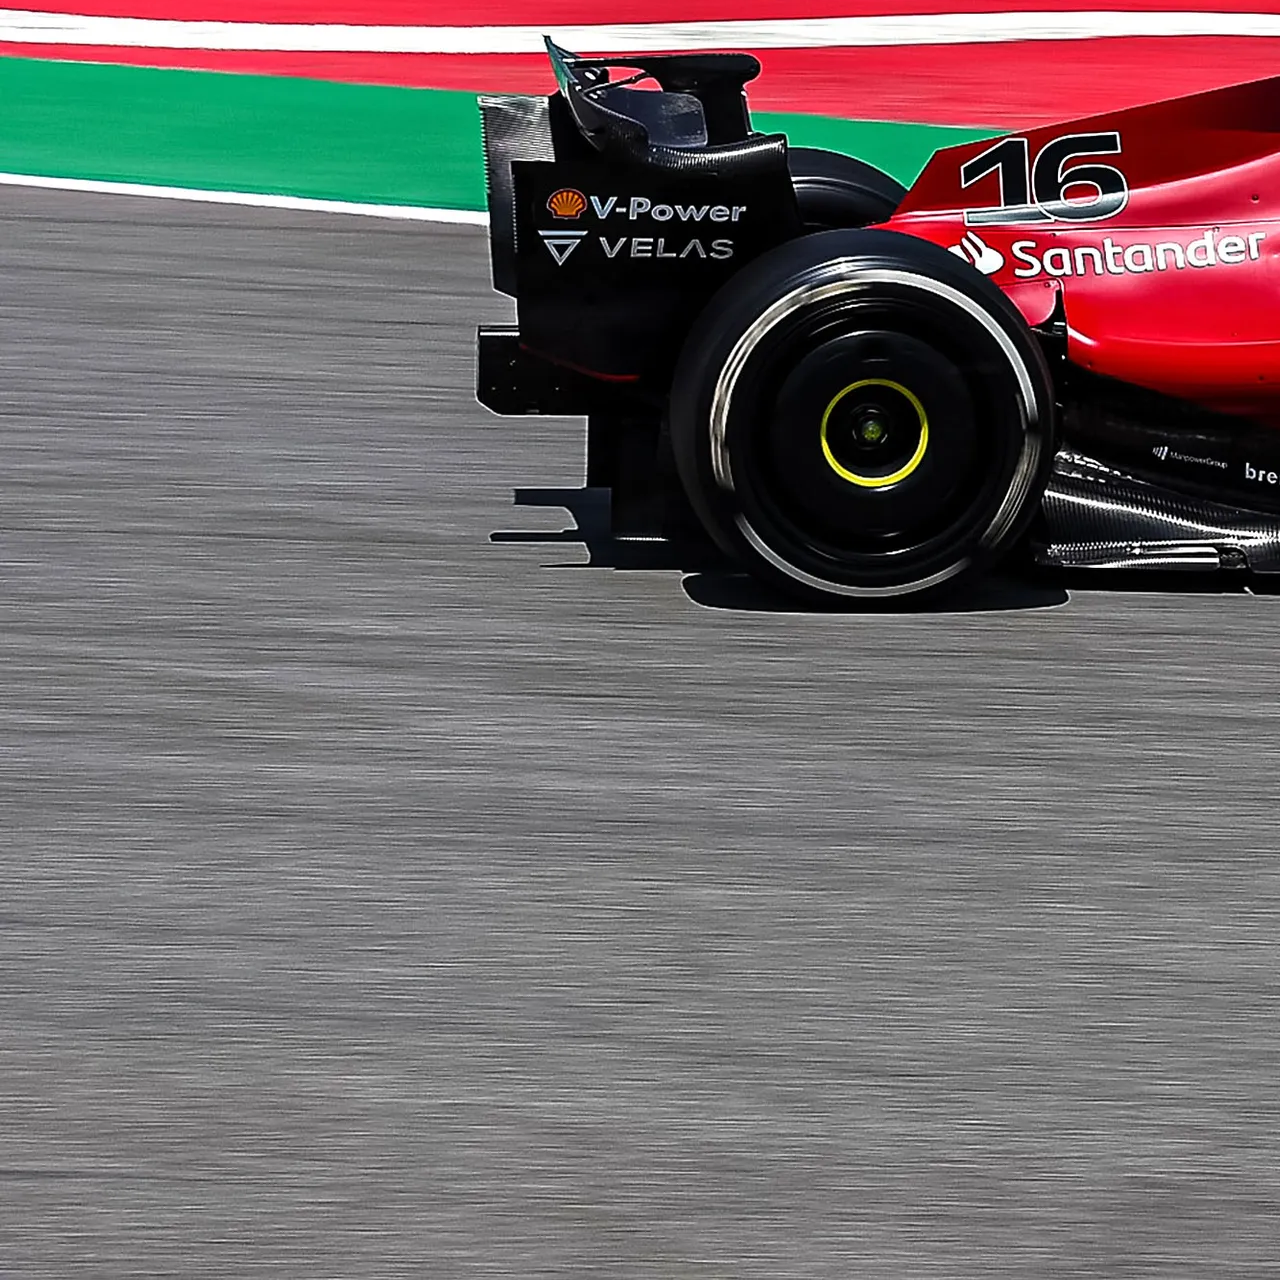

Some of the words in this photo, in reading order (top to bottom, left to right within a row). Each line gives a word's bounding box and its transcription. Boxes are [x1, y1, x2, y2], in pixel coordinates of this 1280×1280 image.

[961, 132, 1128, 226] 16
[590, 196, 747, 222] V-Power
[598, 236, 734, 260] VELAS
[1011, 229, 1268, 278] Santander
